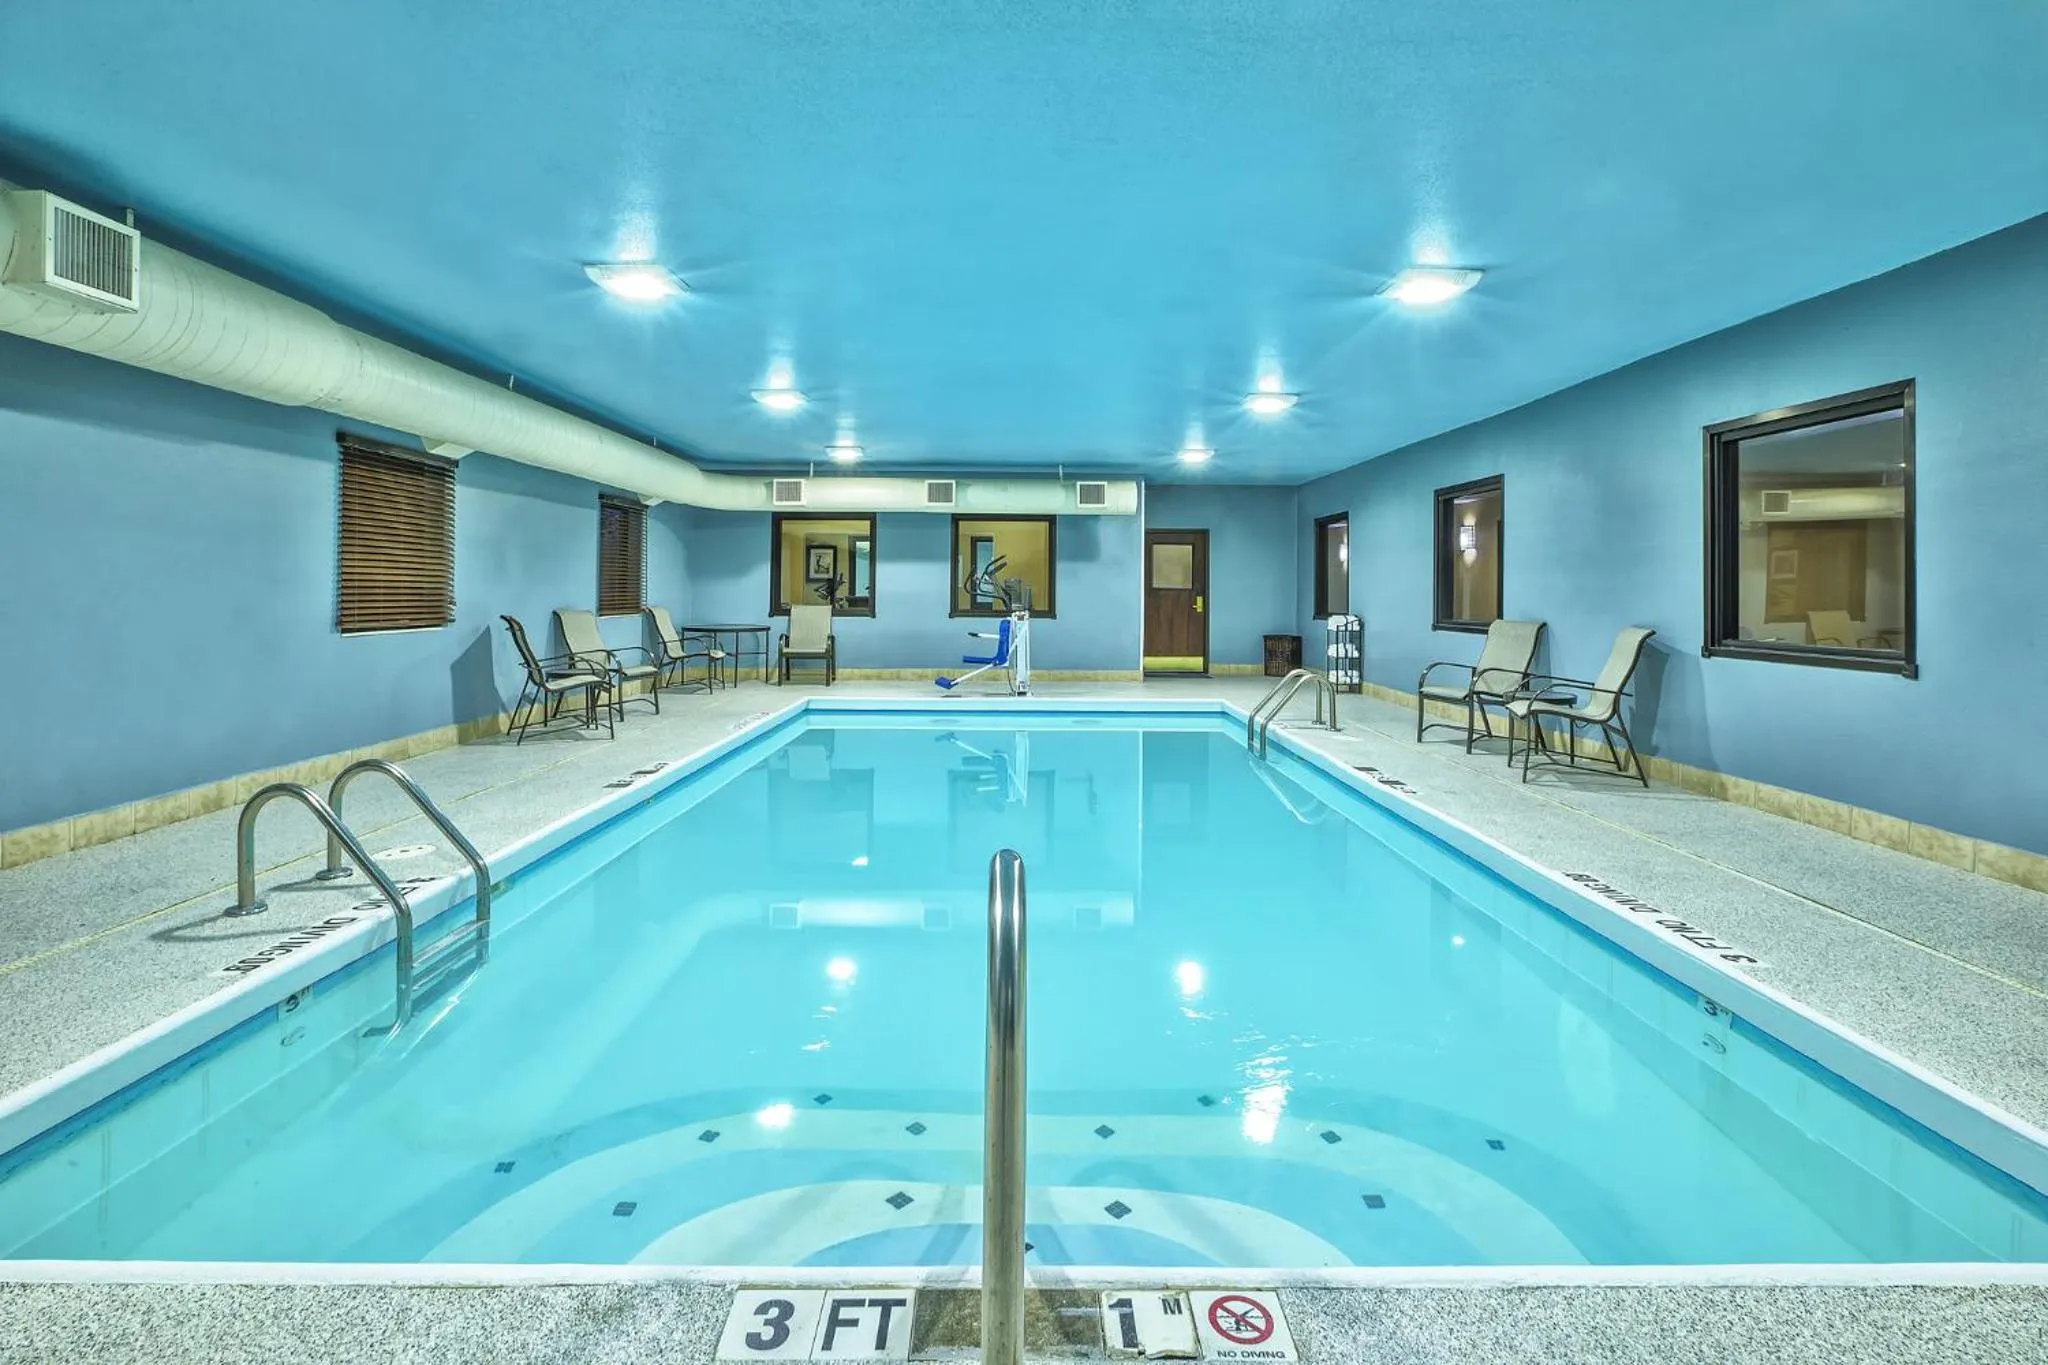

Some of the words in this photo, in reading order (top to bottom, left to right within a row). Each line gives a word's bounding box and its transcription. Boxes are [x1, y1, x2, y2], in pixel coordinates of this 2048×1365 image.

[1584, 883, 1662, 913] DIVING
[258, 917, 358, 956] DIVING
[1656, 919, 1702, 933] NO
[1681, 934, 1733, 950] FT
[1720, 953, 1758, 963] 3
[745, 1298, 795, 1351] 3
[821, 1298, 907, 1351] FT
[1108, 1298, 1138, 1348] 1
[1161, 1297, 1183, 1315] M
[1217, 1350, 1237, 1358] NO
[1240, 1350, 1286, 1359] DIVING
